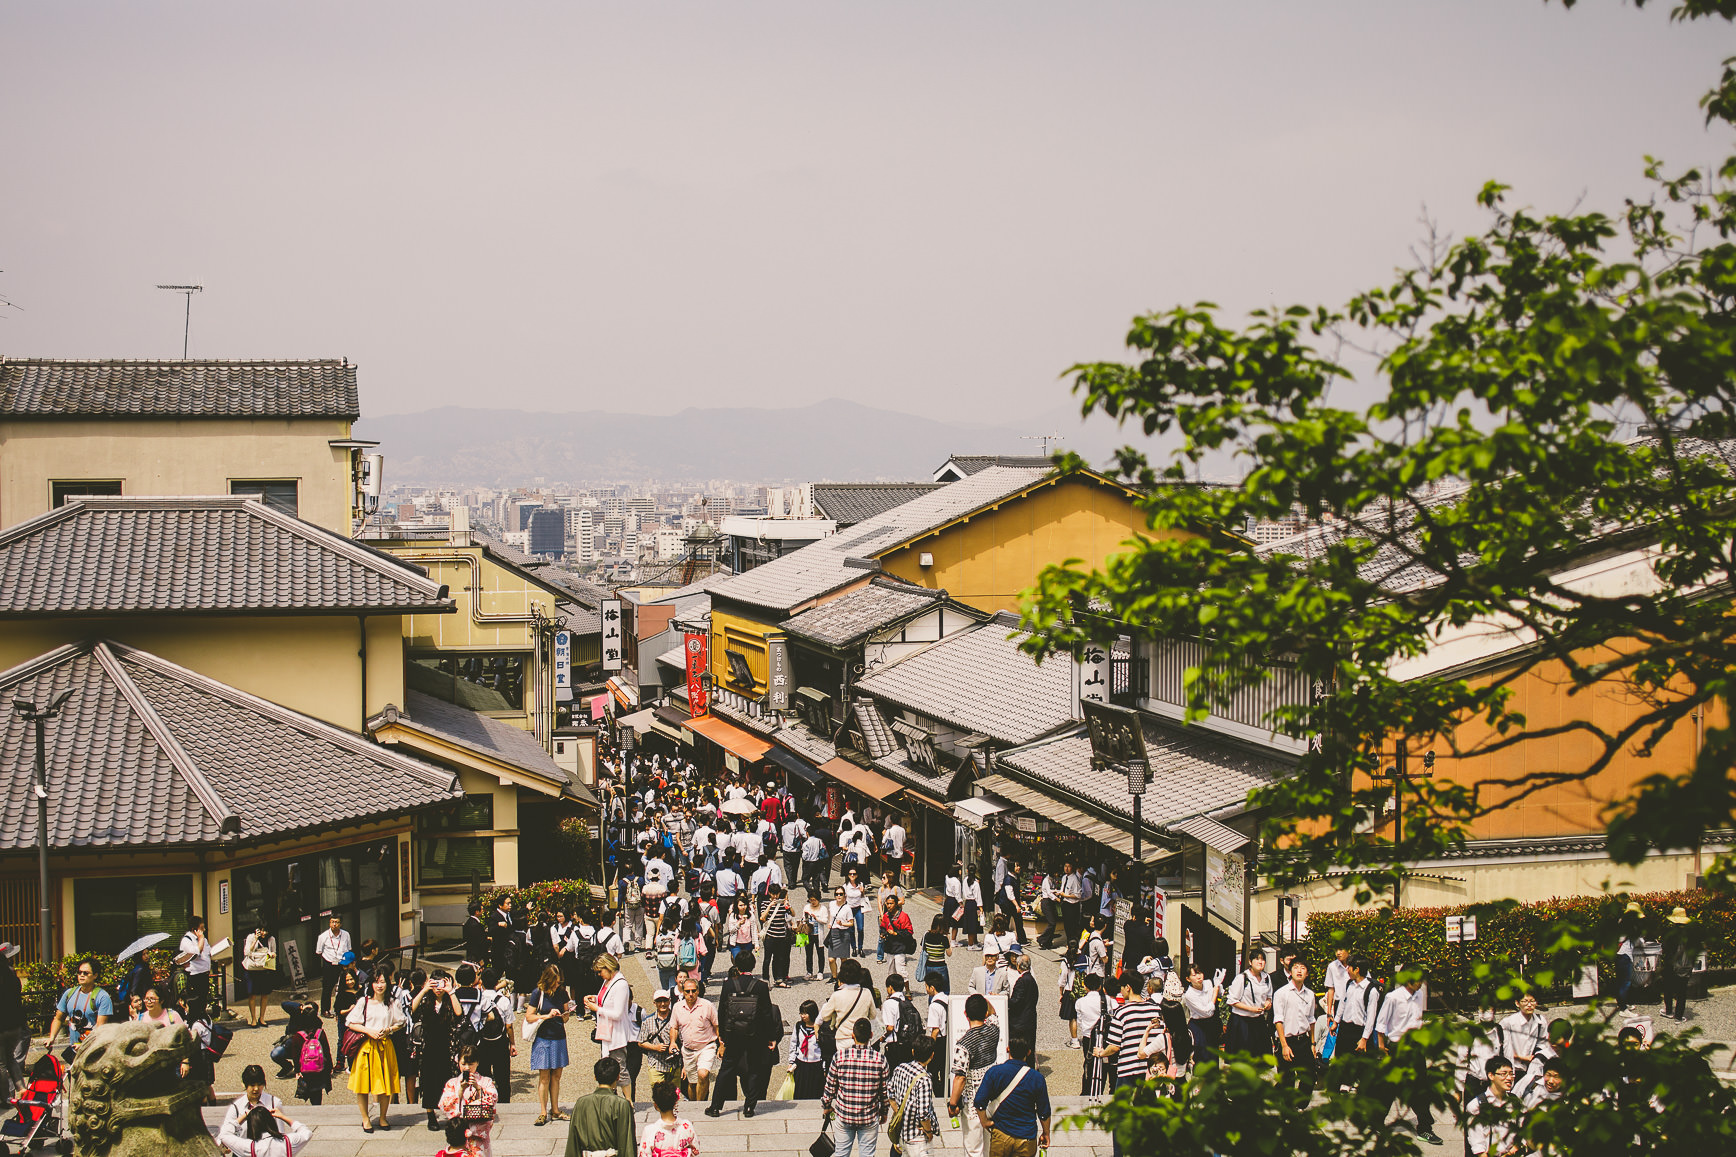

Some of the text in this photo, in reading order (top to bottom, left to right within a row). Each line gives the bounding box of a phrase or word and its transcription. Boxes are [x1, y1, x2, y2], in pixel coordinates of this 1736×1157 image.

[605, 608, 621, 662] 梅山堂
[556, 647, 566, 684] 朝日堂
[773, 674, 786, 704] 西利
[1311, 676, 1324, 755] 食処
[1156, 892, 1164, 938] KIR
